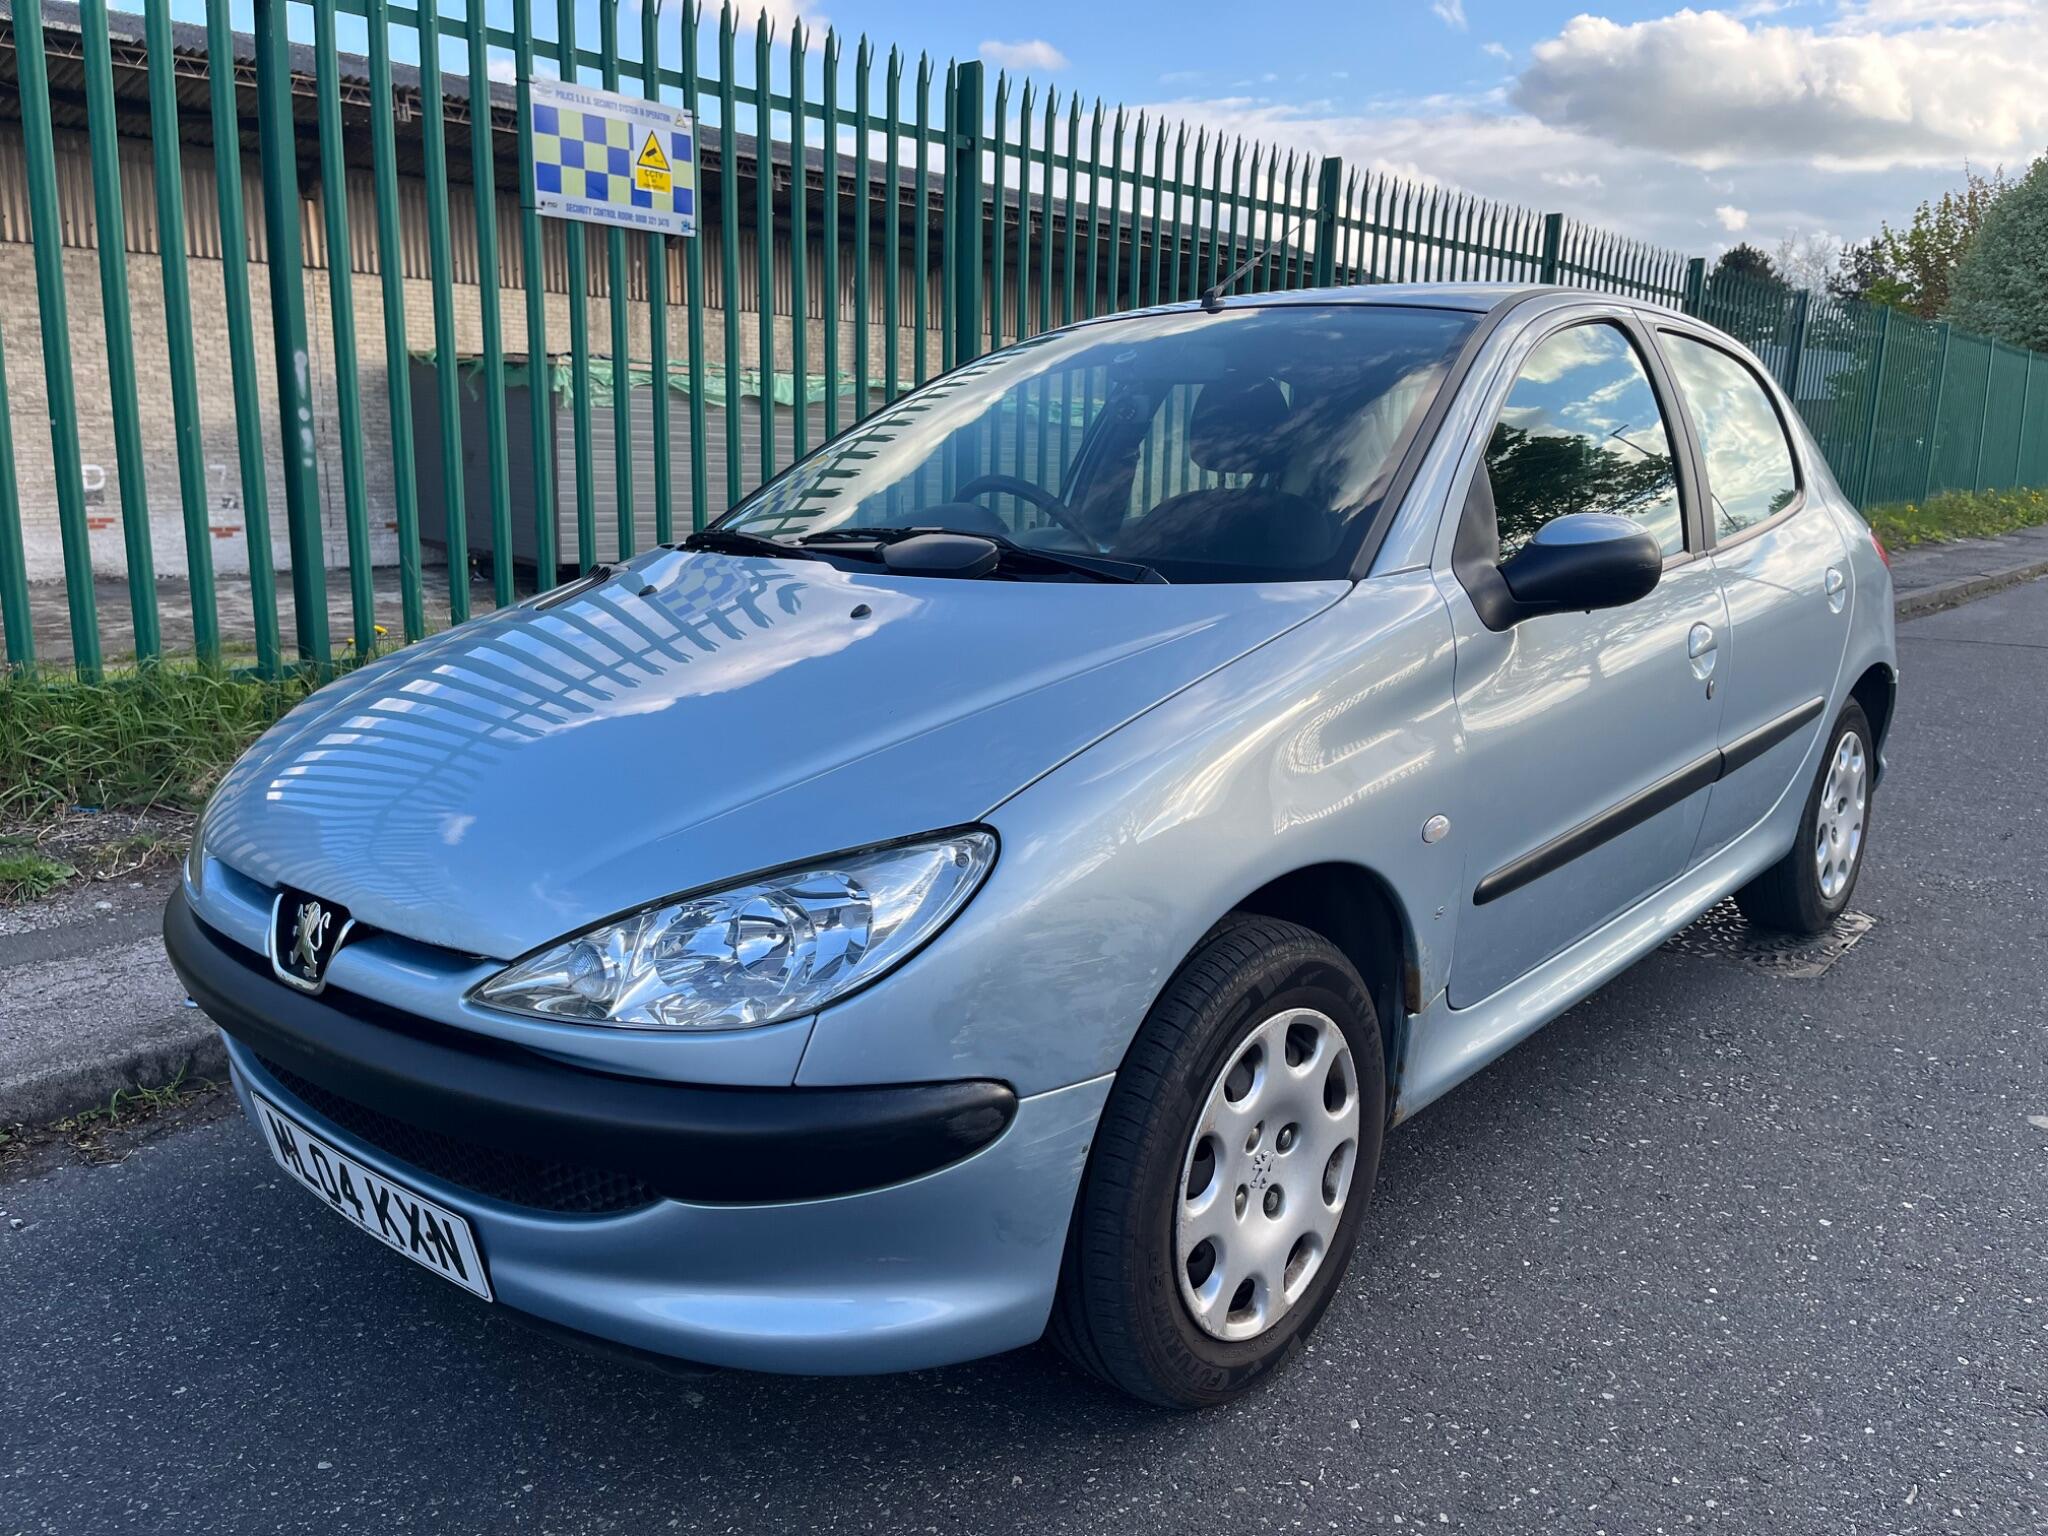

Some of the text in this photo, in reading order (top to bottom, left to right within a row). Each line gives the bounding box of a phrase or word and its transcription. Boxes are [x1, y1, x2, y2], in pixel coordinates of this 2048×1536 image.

[644, 169, 664, 180] CCTV
[565, 203, 593, 215] SECURITY
[593, 206, 617, 218] CONTROL
[265, 1109, 365, 1221] ML04
[363, 1176, 469, 1281] KXN
